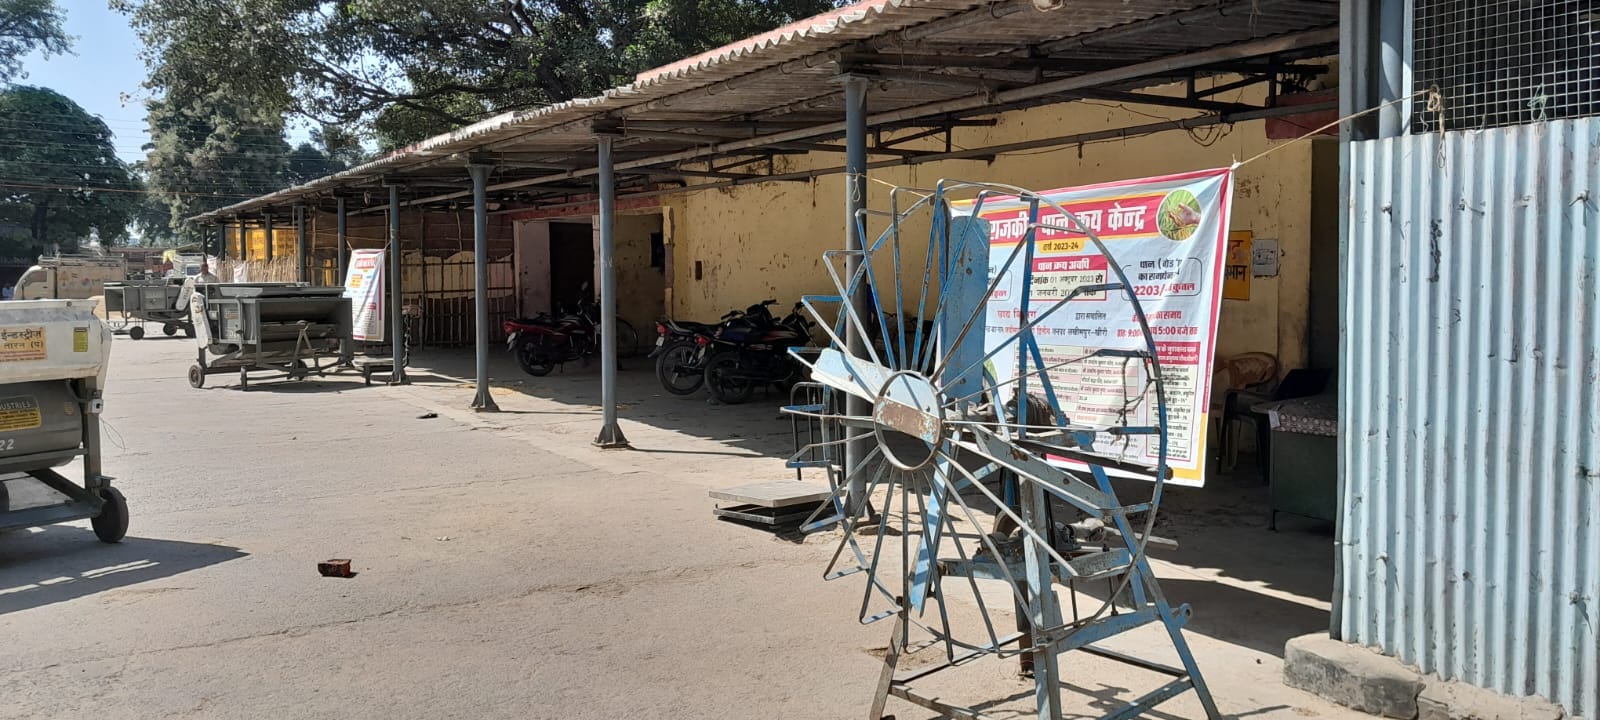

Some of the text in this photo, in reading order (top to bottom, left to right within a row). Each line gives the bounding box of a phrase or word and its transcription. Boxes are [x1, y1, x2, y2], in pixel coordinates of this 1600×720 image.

[990, 210, 1031, 240] राजकी
[1107, 202, 1147, 232] केन्द्र
[1053, 241, 1079, 250] 2023-24
[1158, 326, 1176, 336] 5:00
